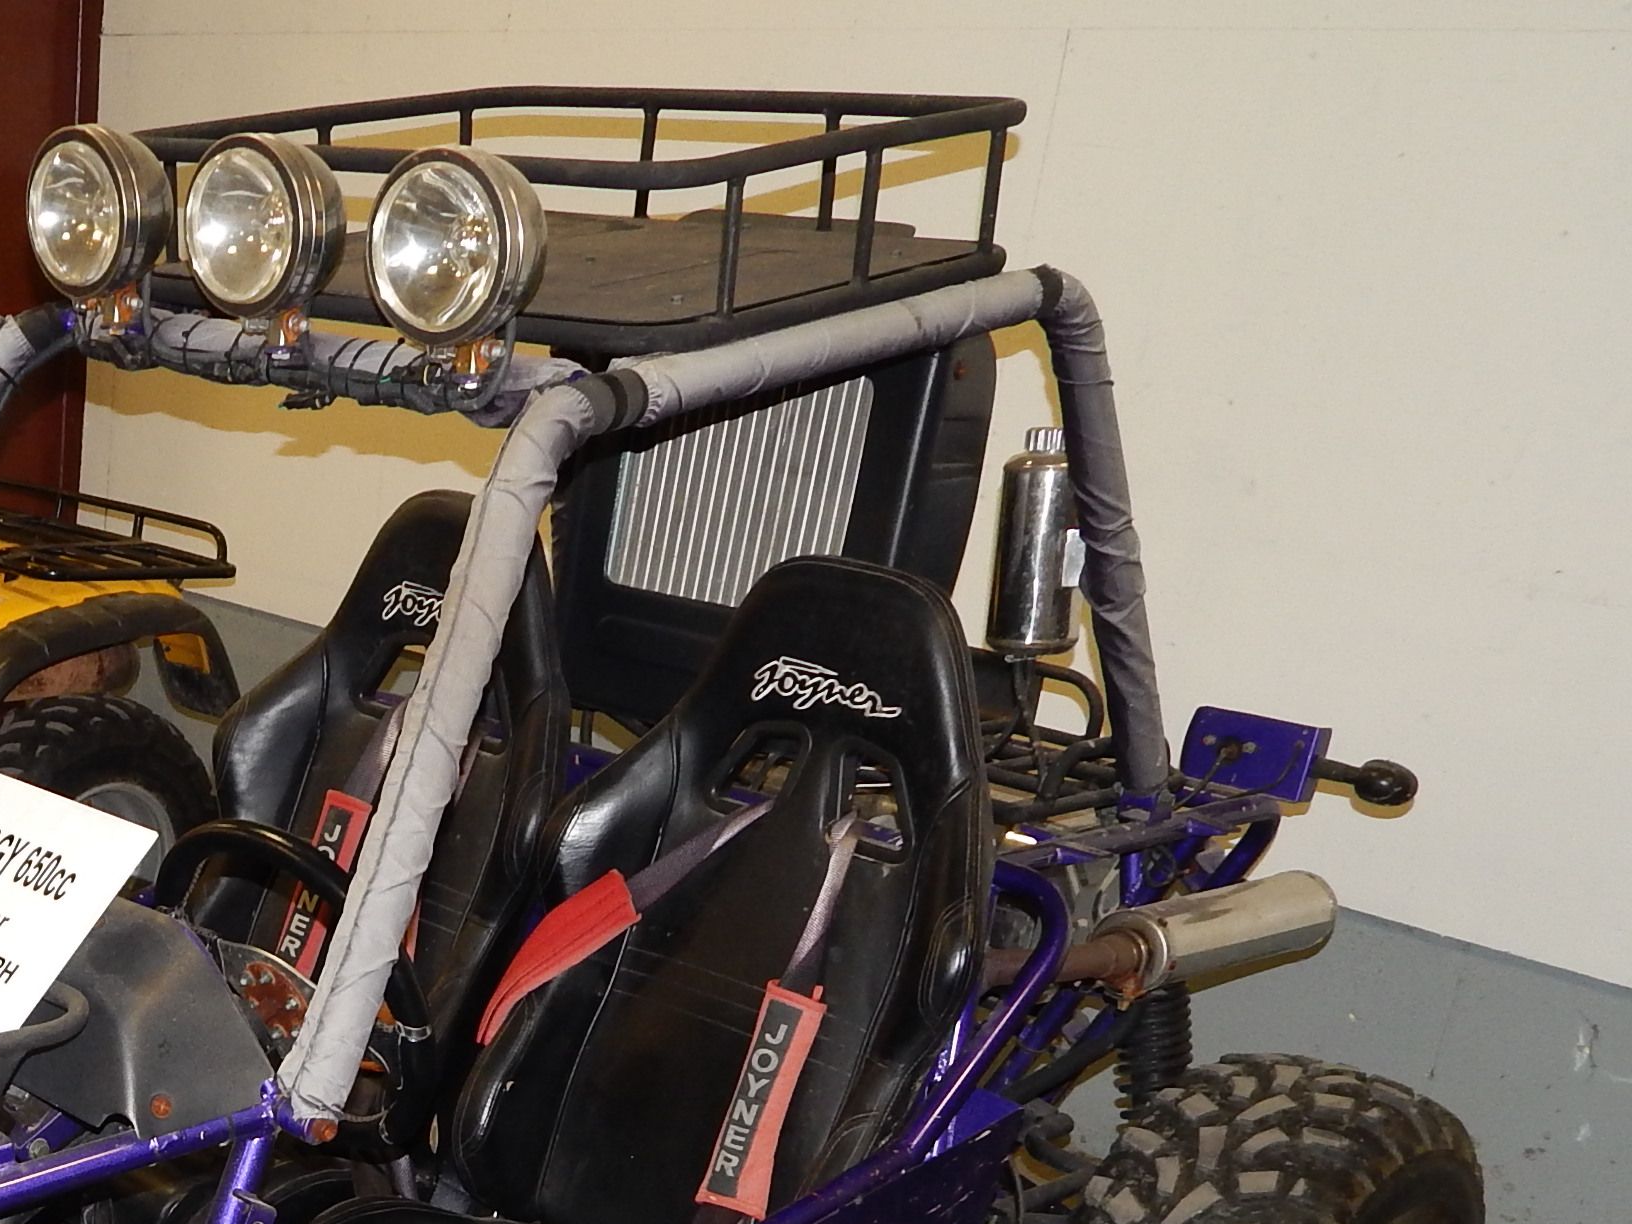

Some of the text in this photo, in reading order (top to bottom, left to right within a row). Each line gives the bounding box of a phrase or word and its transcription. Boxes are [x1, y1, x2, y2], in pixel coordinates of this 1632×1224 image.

[751, 656, 903, 718] Joyner
[13, 846, 77, 900] 650cc
[714, 1023, 789, 1177] JOYNER
